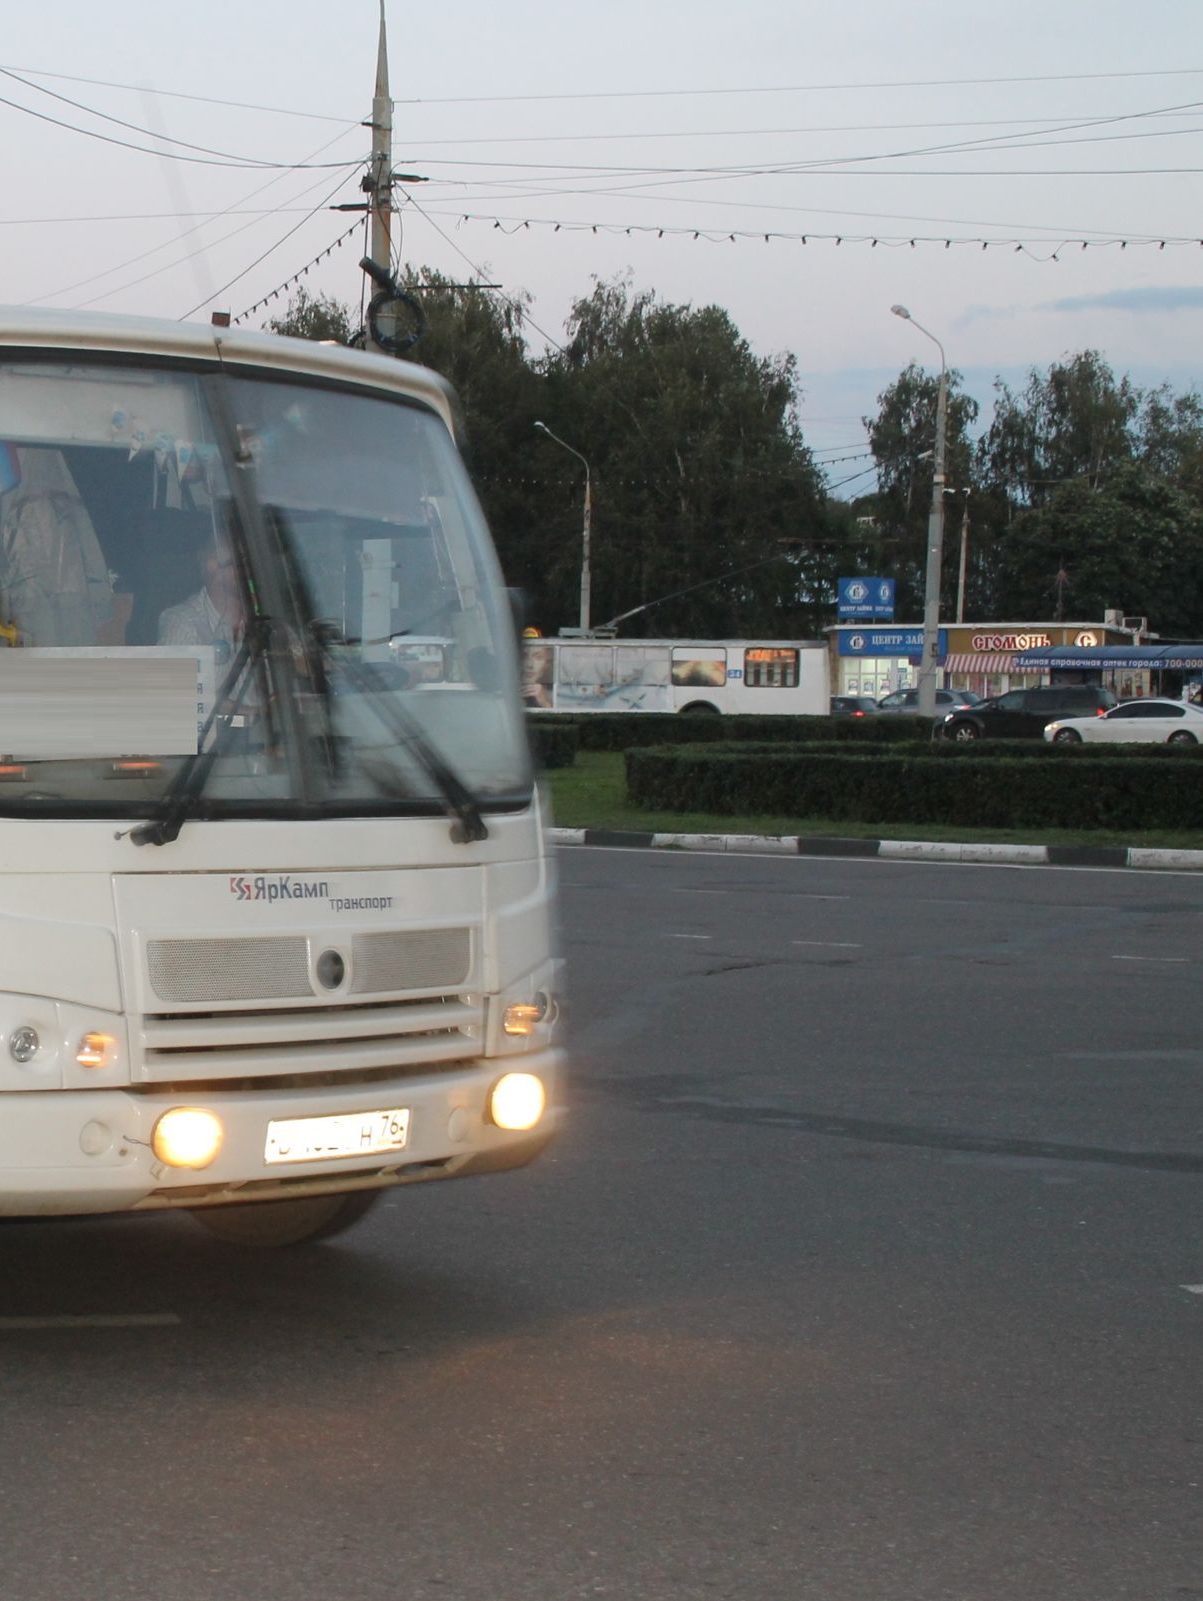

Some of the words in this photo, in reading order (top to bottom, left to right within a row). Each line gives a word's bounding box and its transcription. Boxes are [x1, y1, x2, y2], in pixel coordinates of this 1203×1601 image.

[872, 635, 902, 645] ЦЕНТР
[905, 633, 924, 645] ЗАЙ
[1020, 657, 1048, 665] Единая
[1050, 658, 1100, 668] справочная
[254, 876, 329, 903] ЯрКамп
[329, 896, 392, 912] транспорт
[381, 1114, 399, 1137] 76
